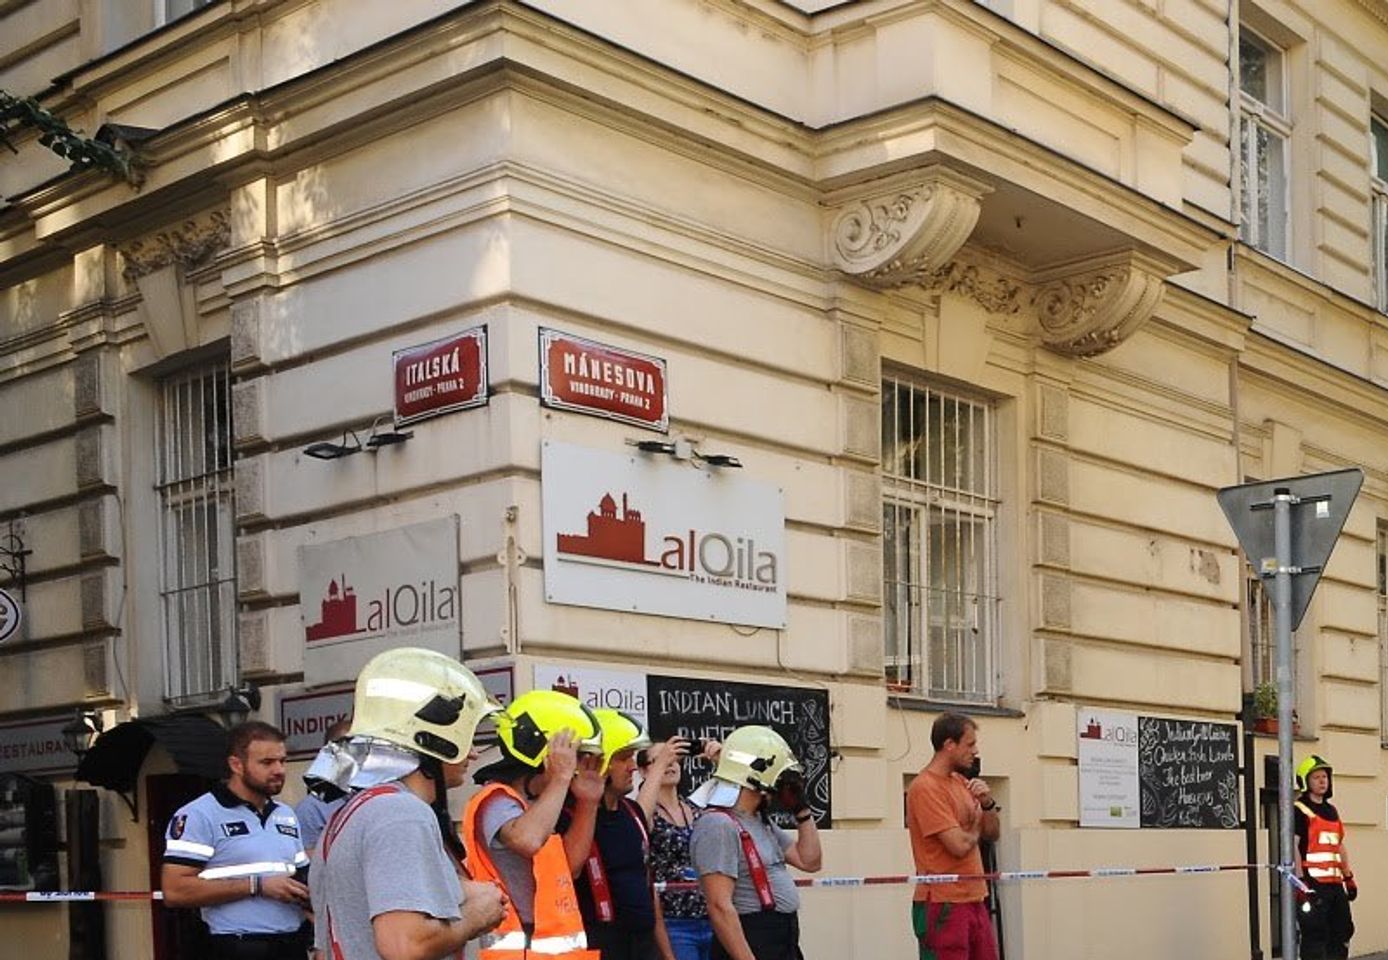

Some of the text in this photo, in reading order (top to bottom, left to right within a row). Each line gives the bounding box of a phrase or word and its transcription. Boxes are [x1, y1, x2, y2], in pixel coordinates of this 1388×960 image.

[405, 346, 460, 387] ITALSKÁ
[563, 352, 655, 395] MÁNESOVA
[689, 574, 777, 593] The Indian Restaurant
[659, 690, 732, 716] INDIAN
